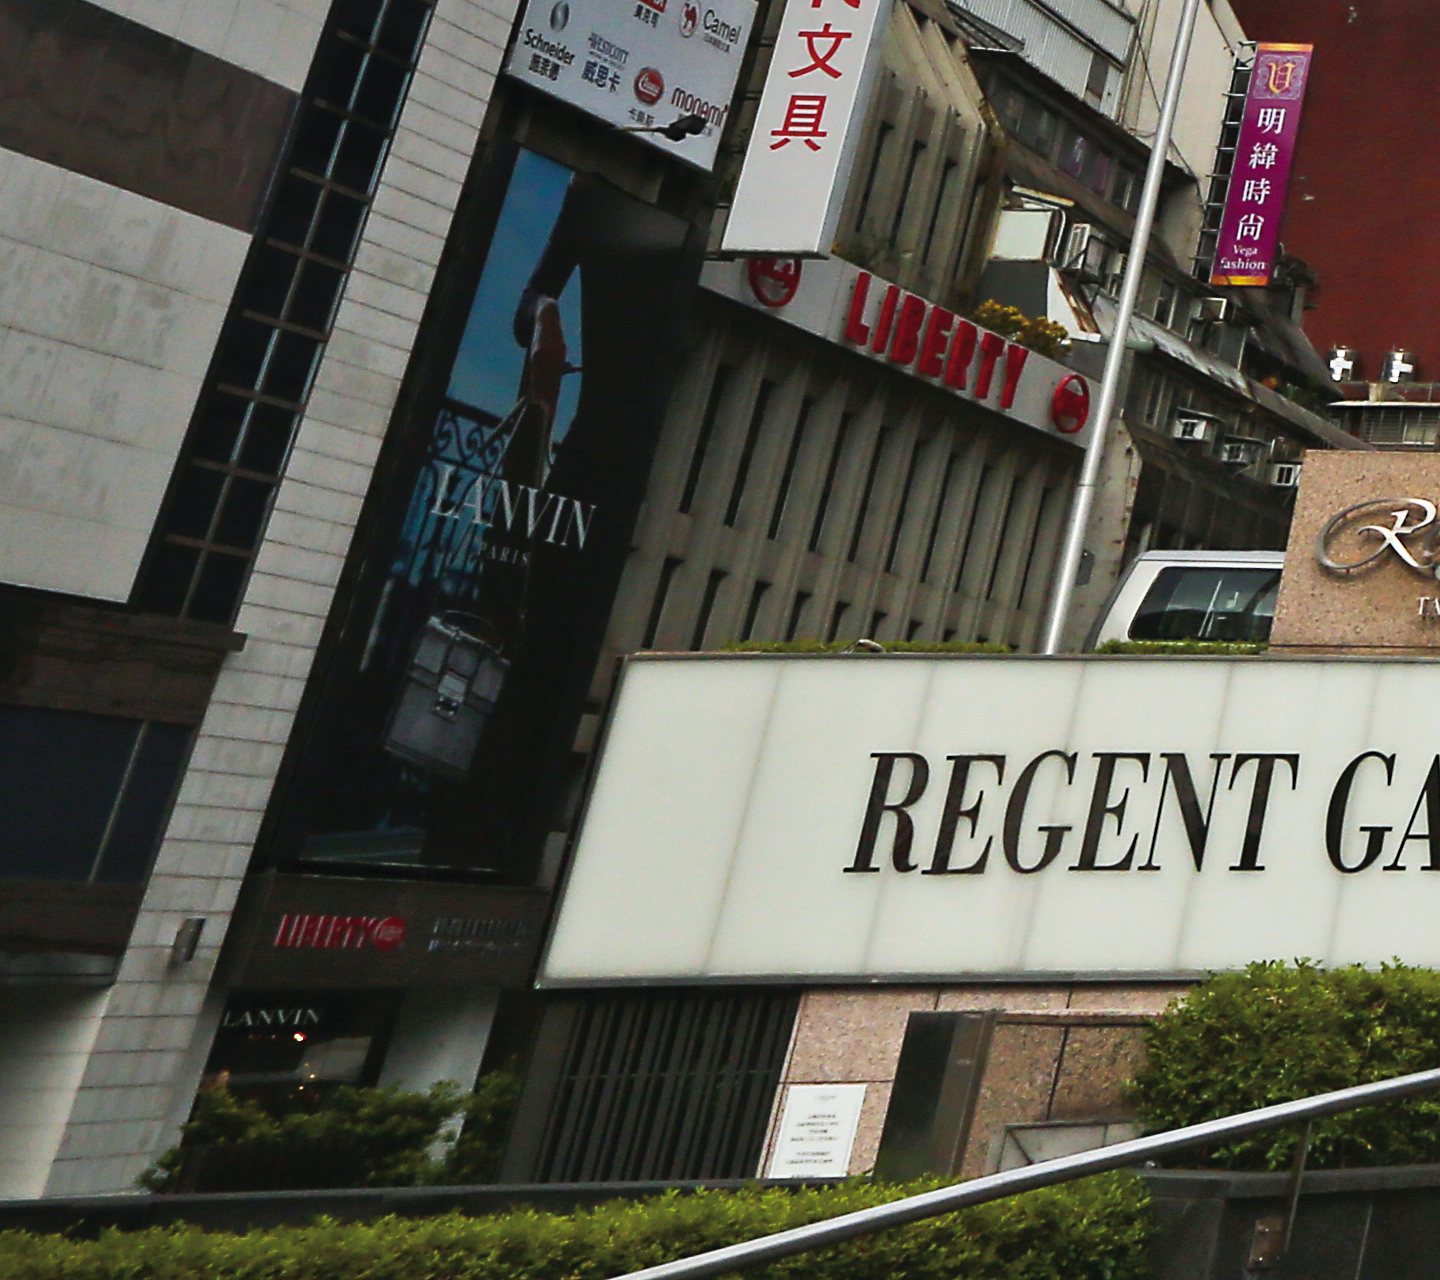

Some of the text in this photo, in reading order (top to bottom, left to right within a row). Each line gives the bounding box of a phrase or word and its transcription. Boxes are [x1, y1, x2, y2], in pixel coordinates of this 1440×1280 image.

[703, 9, 741, 44] Camel
[524, 28, 575, 66] Schneider
[1235, 107, 1287, 242] 明緯時尚
[1219, 257, 1266, 270] fashion
[1233, 244, 1258, 256] Vega
[845, 271, 1029, 409] LIBERTY
[431, 459, 596, 550] LANVIN
[477, 540, 533, 567] PARIS
[842, 750, 1299, 876] REGENT
[222, 1008, 321, 1028] LANVIN
